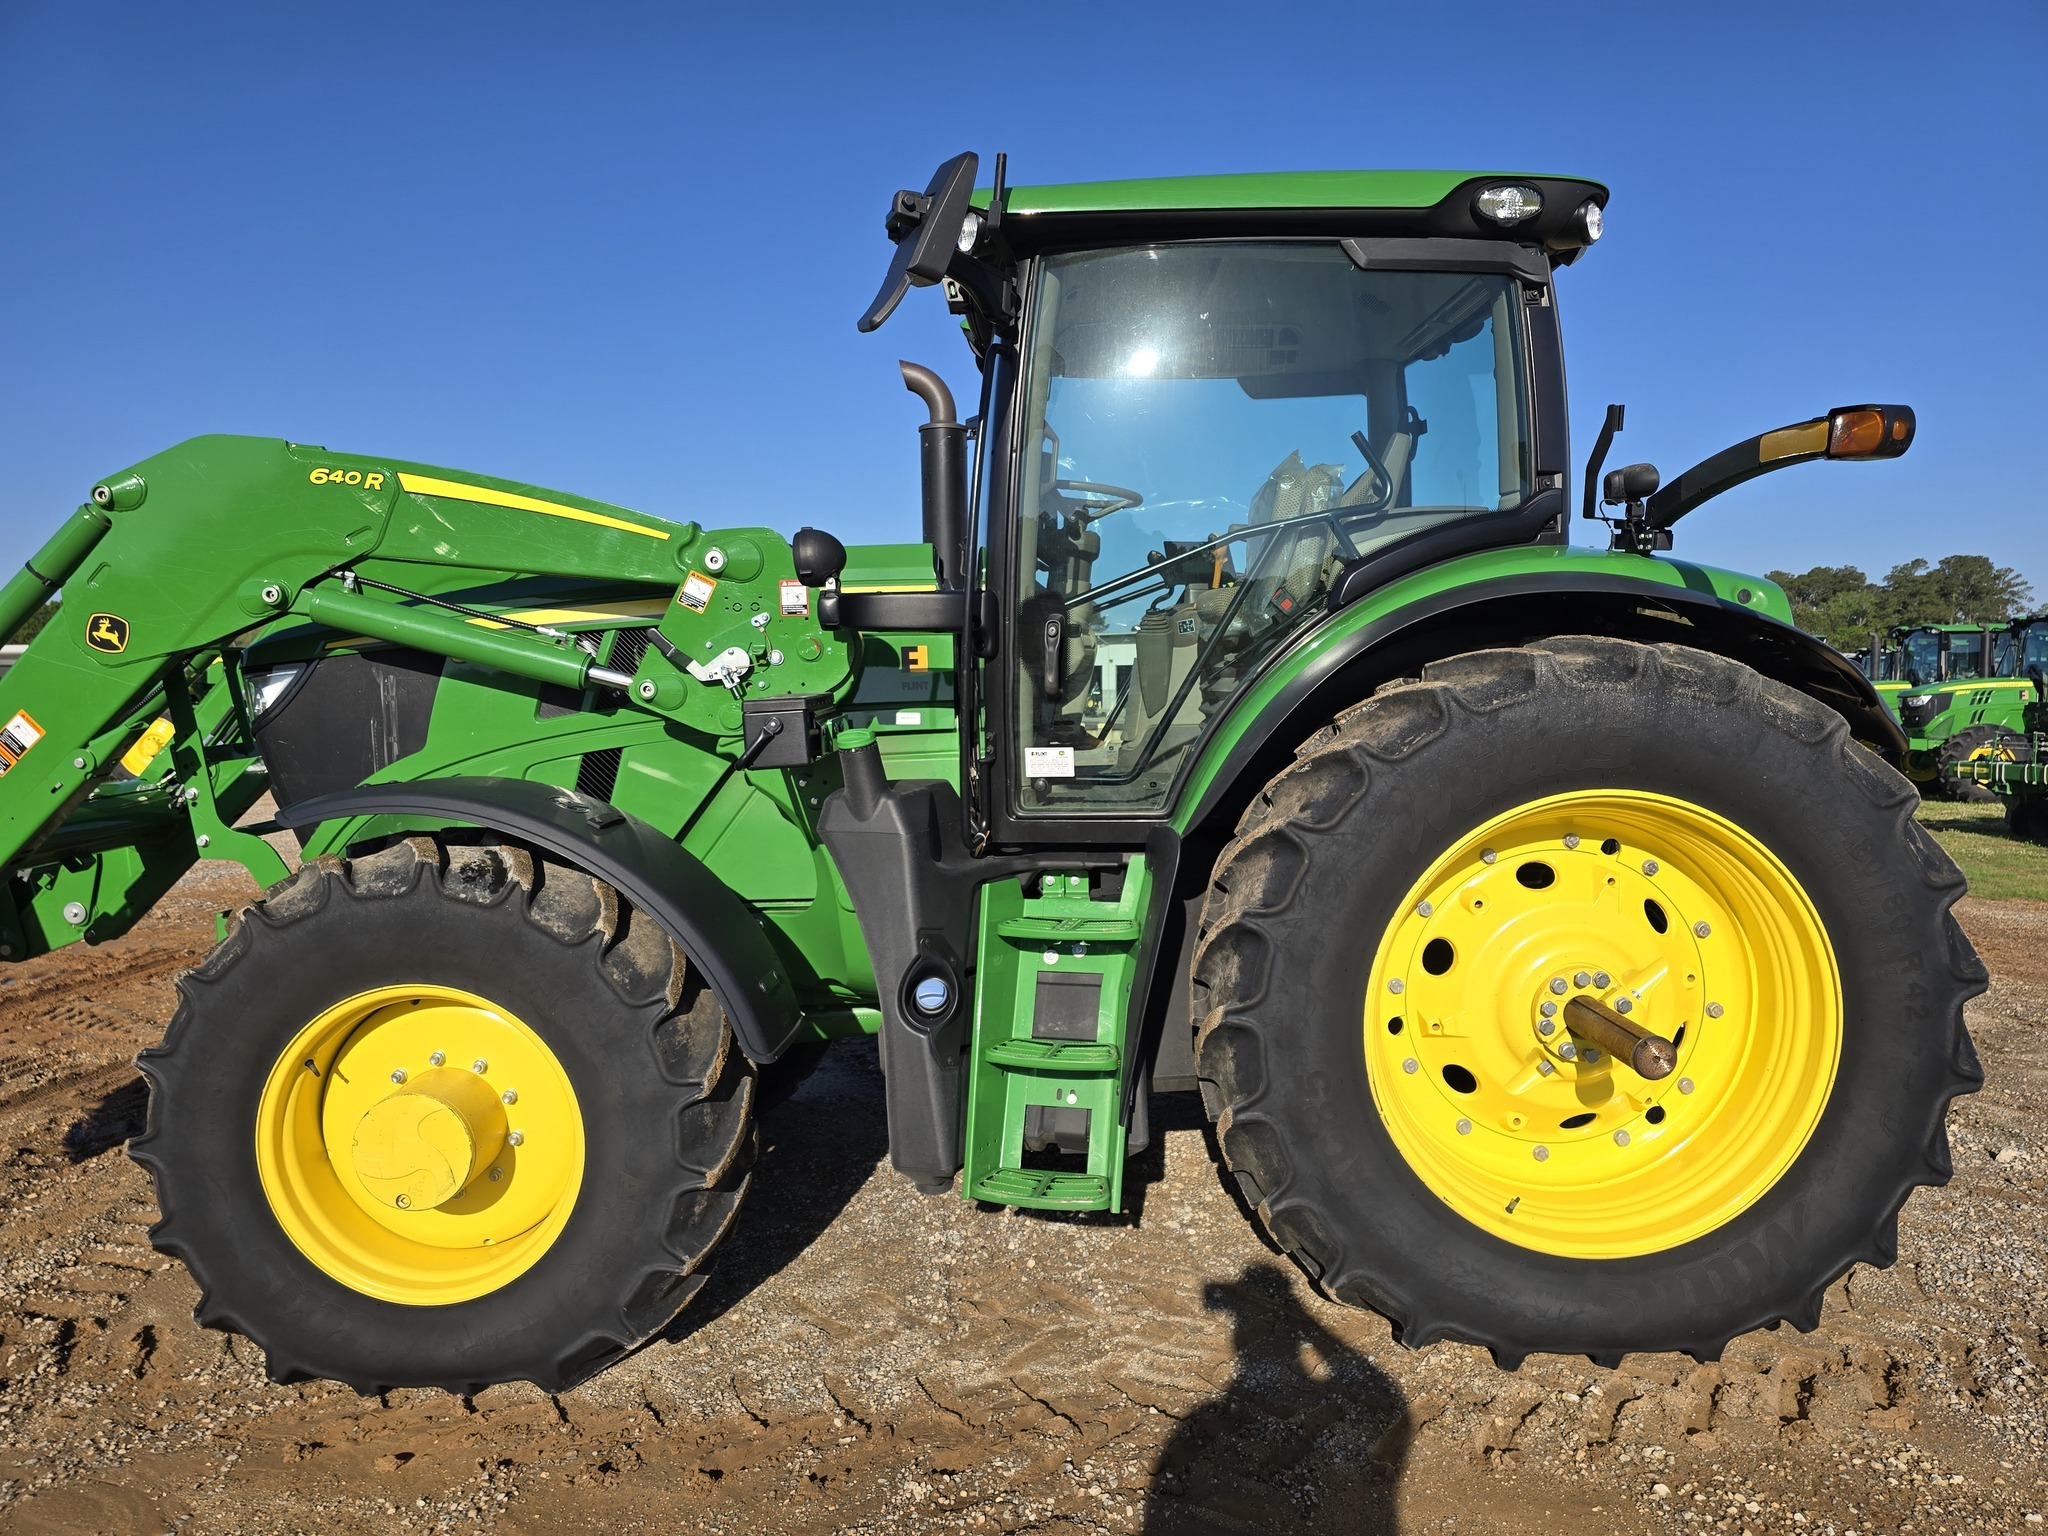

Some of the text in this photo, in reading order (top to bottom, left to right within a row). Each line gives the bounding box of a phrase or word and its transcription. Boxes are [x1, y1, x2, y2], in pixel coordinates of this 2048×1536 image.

[309, 467, 385, 491] 640 R
[901, 681, 930, 691] FLINT
